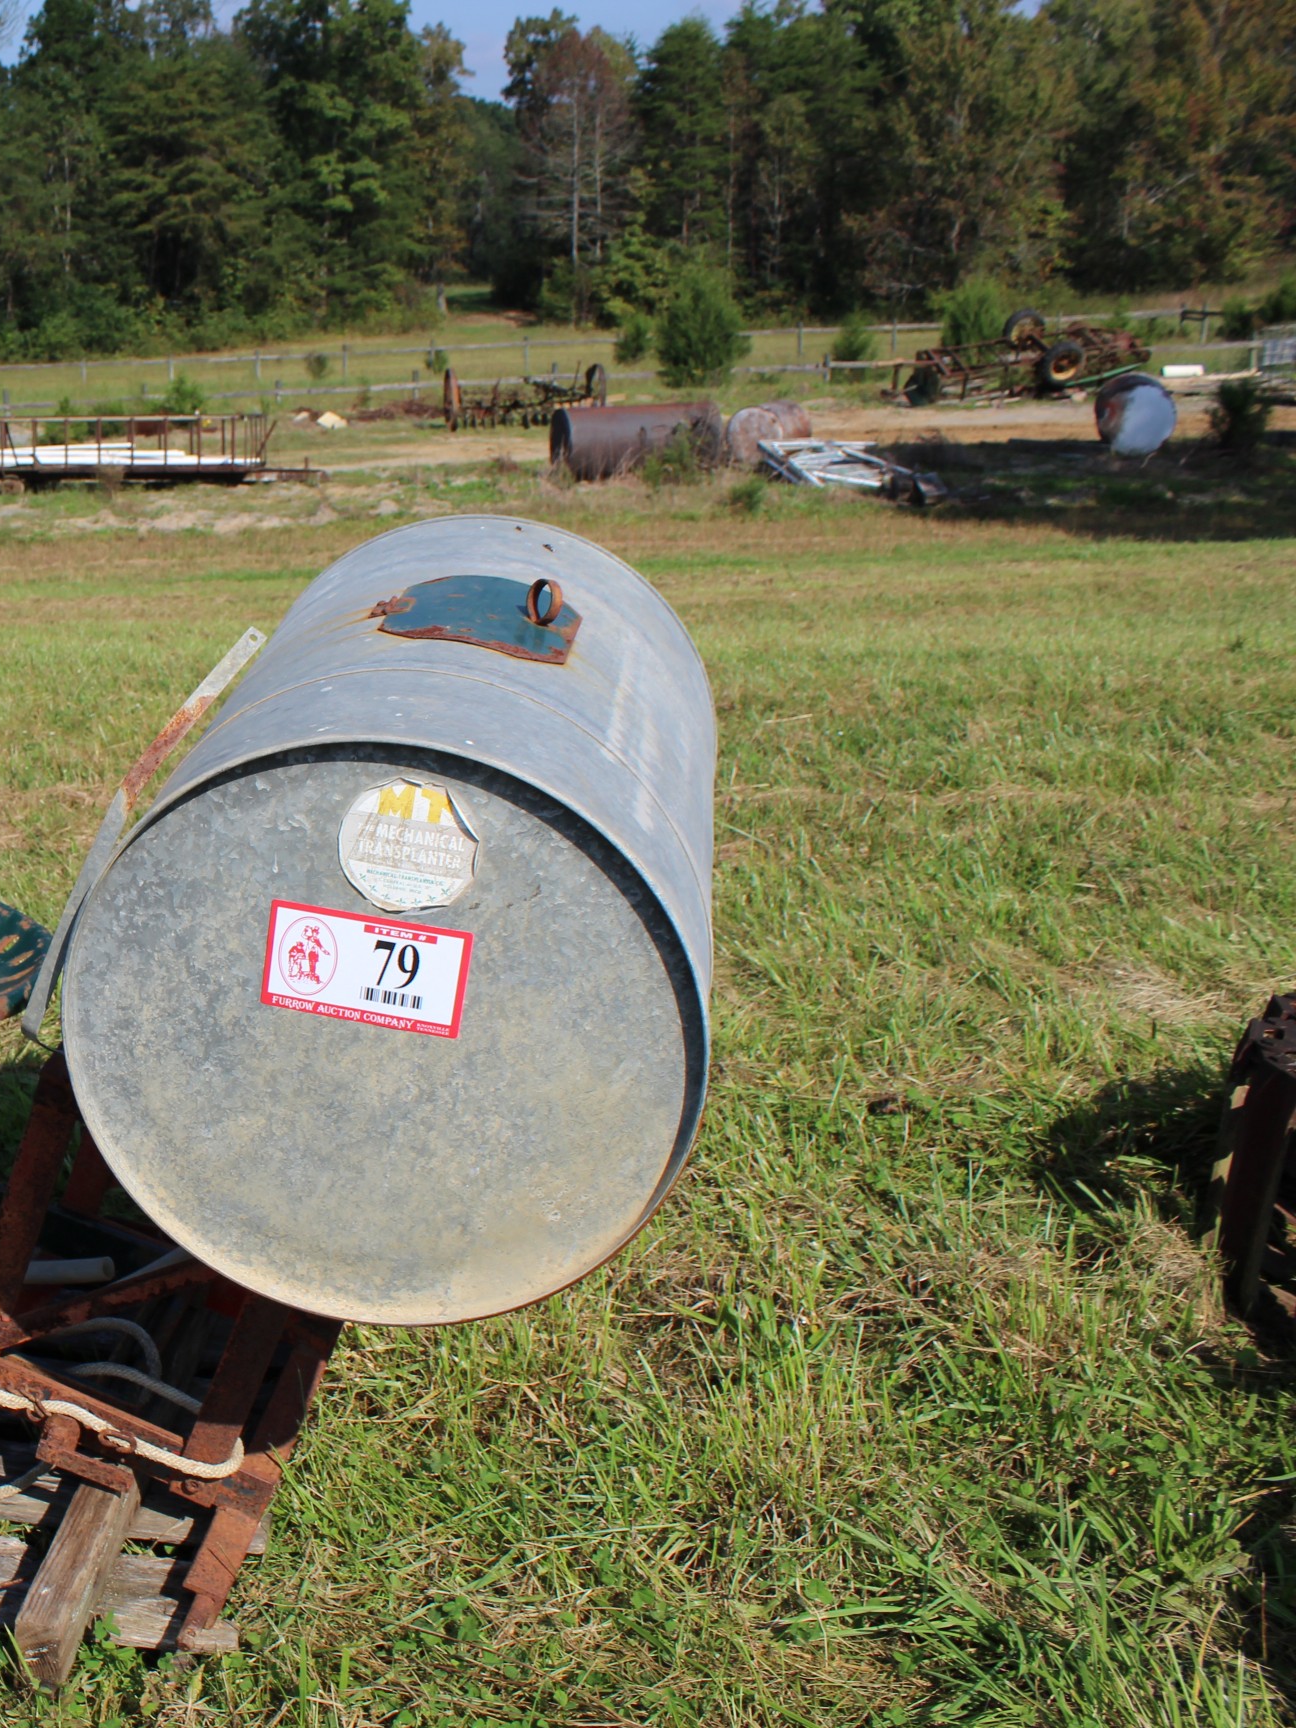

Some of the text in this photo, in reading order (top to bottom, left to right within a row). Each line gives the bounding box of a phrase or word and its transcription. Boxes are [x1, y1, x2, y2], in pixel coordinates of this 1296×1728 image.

[378, 785, 453, 823] MT
[376, 824, 464, 851] MECHANICAL
[358, 839, 461, 869] TRANSPLANTER
[374, 927, 413, 939] ITEM
[373, 940, 420, 989] 79
[272, 995, 415, 1030] FURROW AUCTION COMPANY
